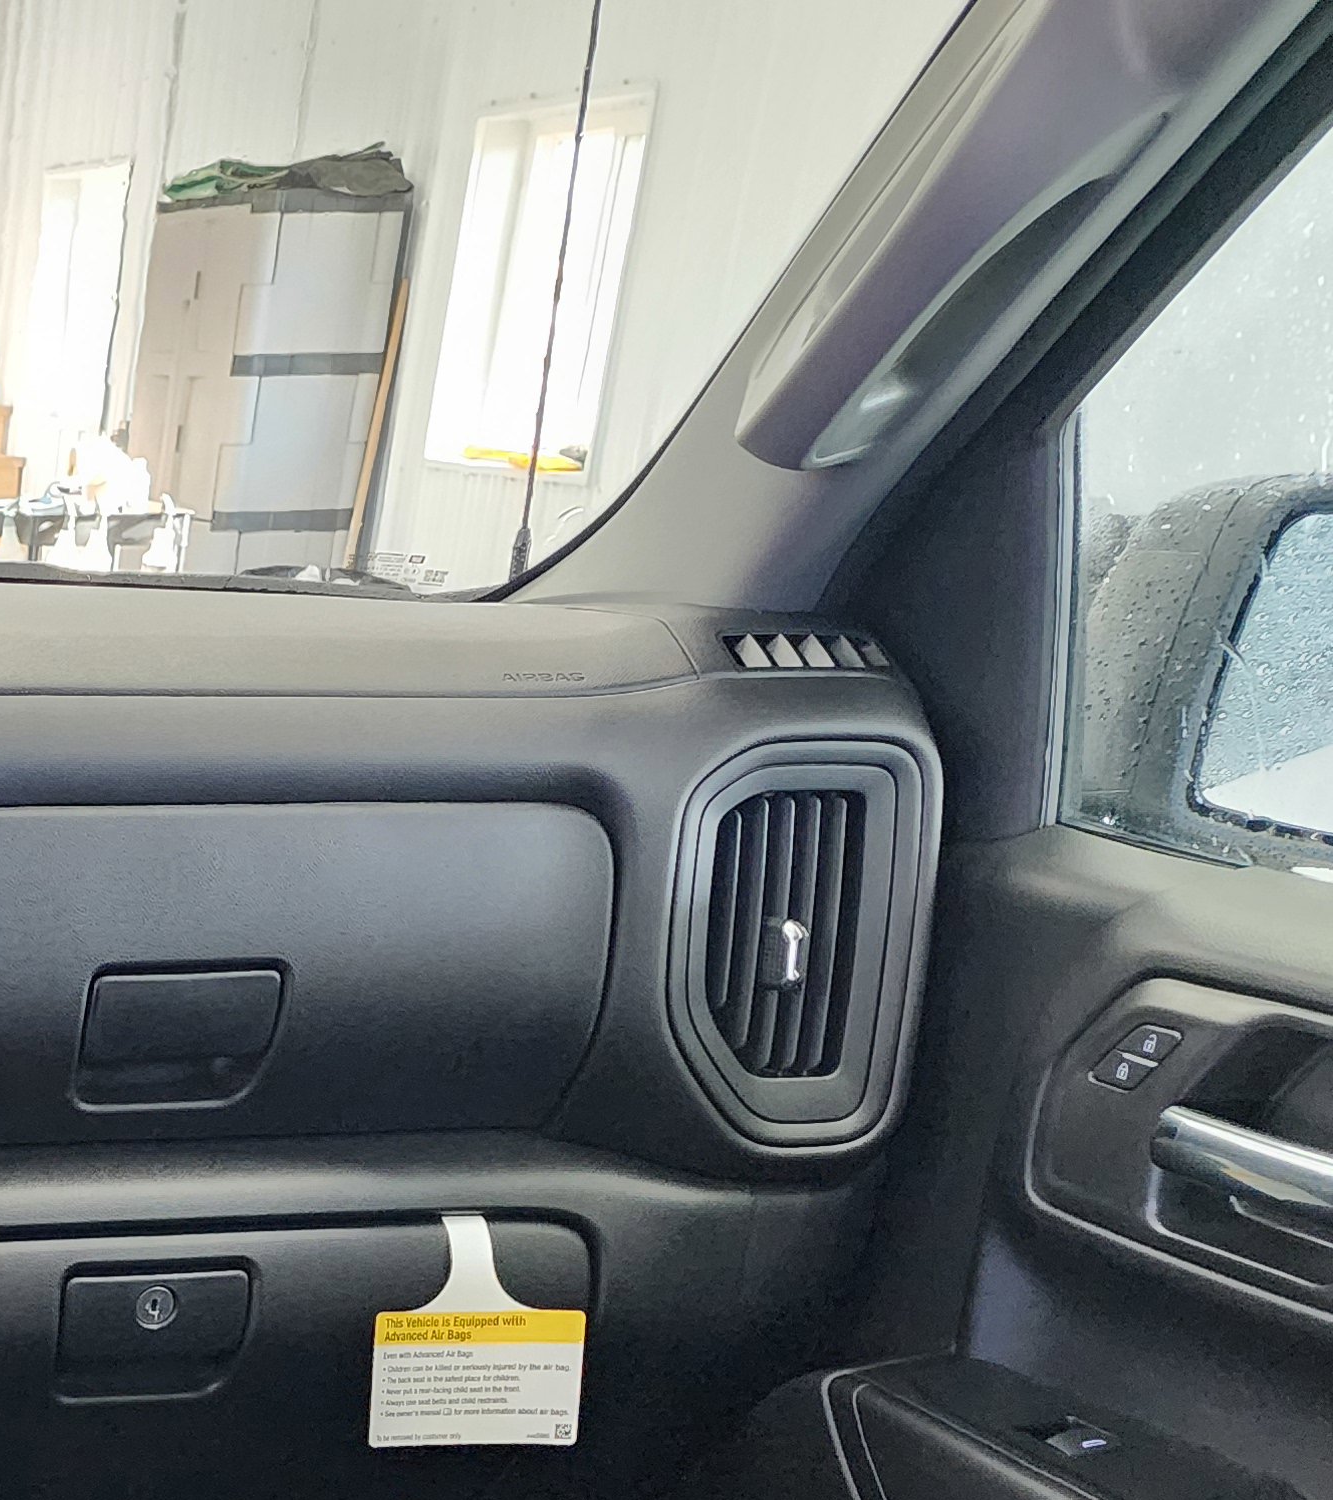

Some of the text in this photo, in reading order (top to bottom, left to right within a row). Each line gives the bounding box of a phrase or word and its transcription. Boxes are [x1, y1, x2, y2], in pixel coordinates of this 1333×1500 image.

[502, 672, 585, 682] AIRBAG
[385, 1317, 404, 1329] This
[406, 1316, 439, 1328] Vehicle
[453, 1315, 500, 1329] Equipped
[502, 1315, 527, 1326] with
[384, 1329, 472, 1342] Advanced Air Bags
[518, 1363, 528, 1372] by
[529, 1363, 541, 1371] the
[542, 1363, 553, 1371] air
[555, 1364, 572, 1372] bag.
